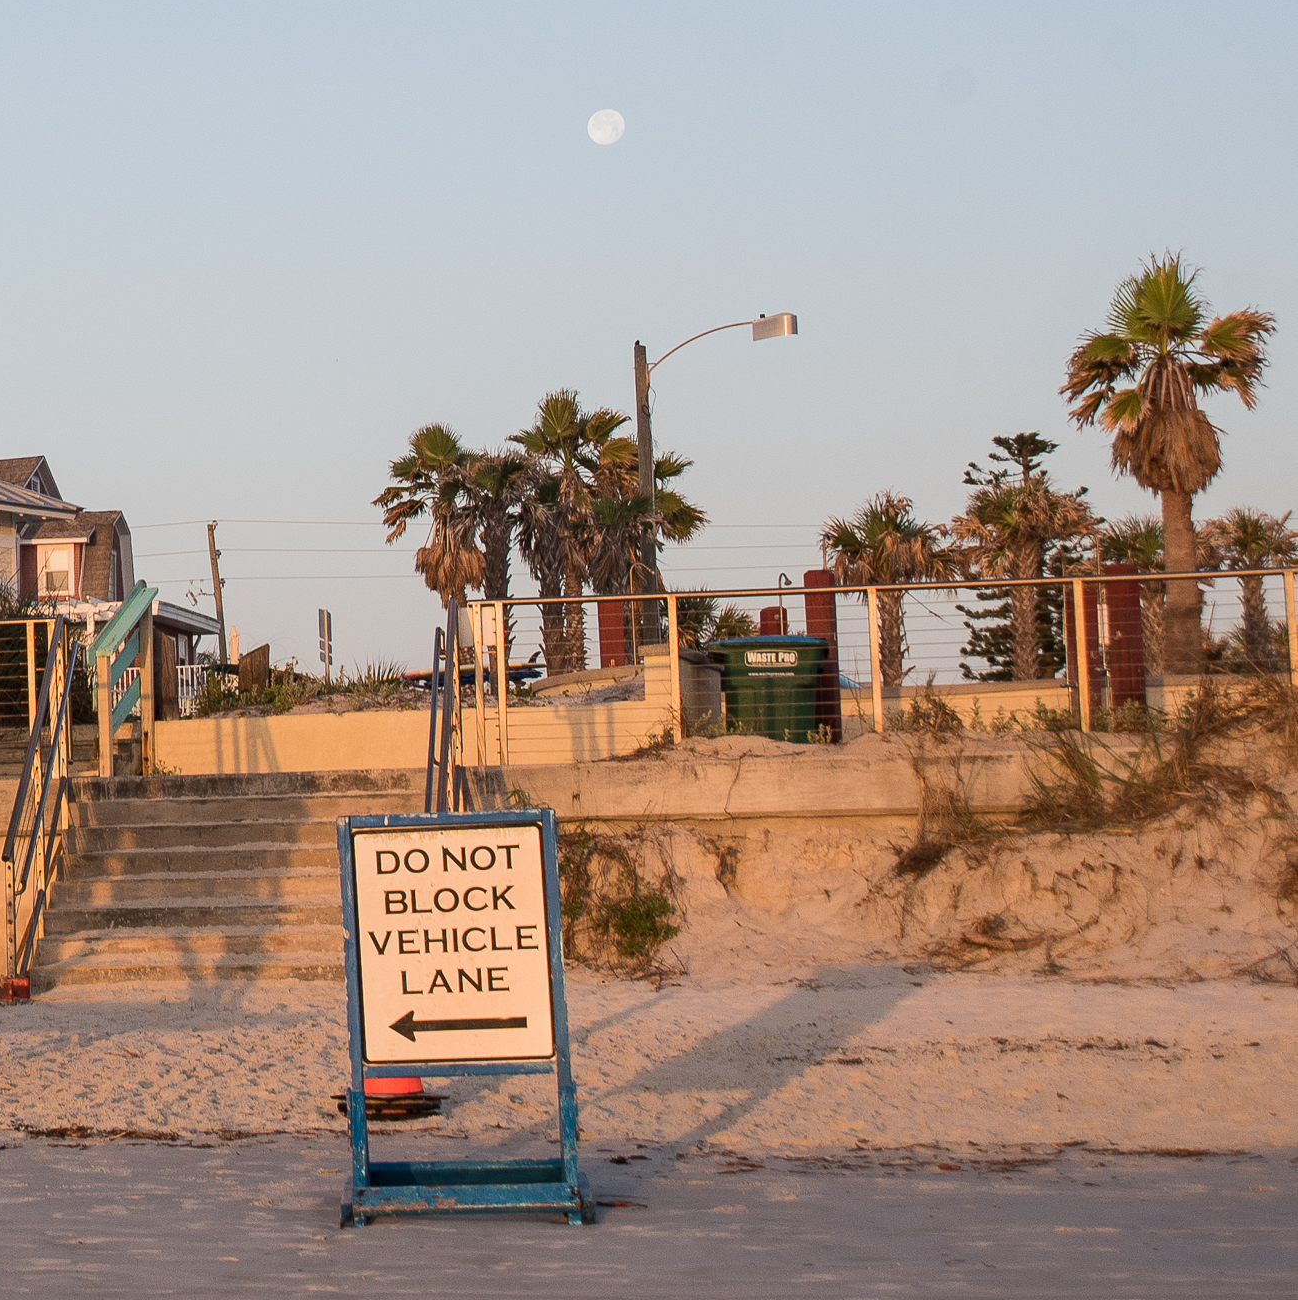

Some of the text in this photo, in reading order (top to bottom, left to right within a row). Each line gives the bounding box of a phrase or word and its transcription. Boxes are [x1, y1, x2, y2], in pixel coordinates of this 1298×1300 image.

[747, 651, 796, 664] WASTE PRO
[374, 843, 520, 875] DO NOT
[383, 885, 517, 915] BLOCK
[367, 925, 539, 956] VEHICLE
[400, 965, 510, 996] LANE
